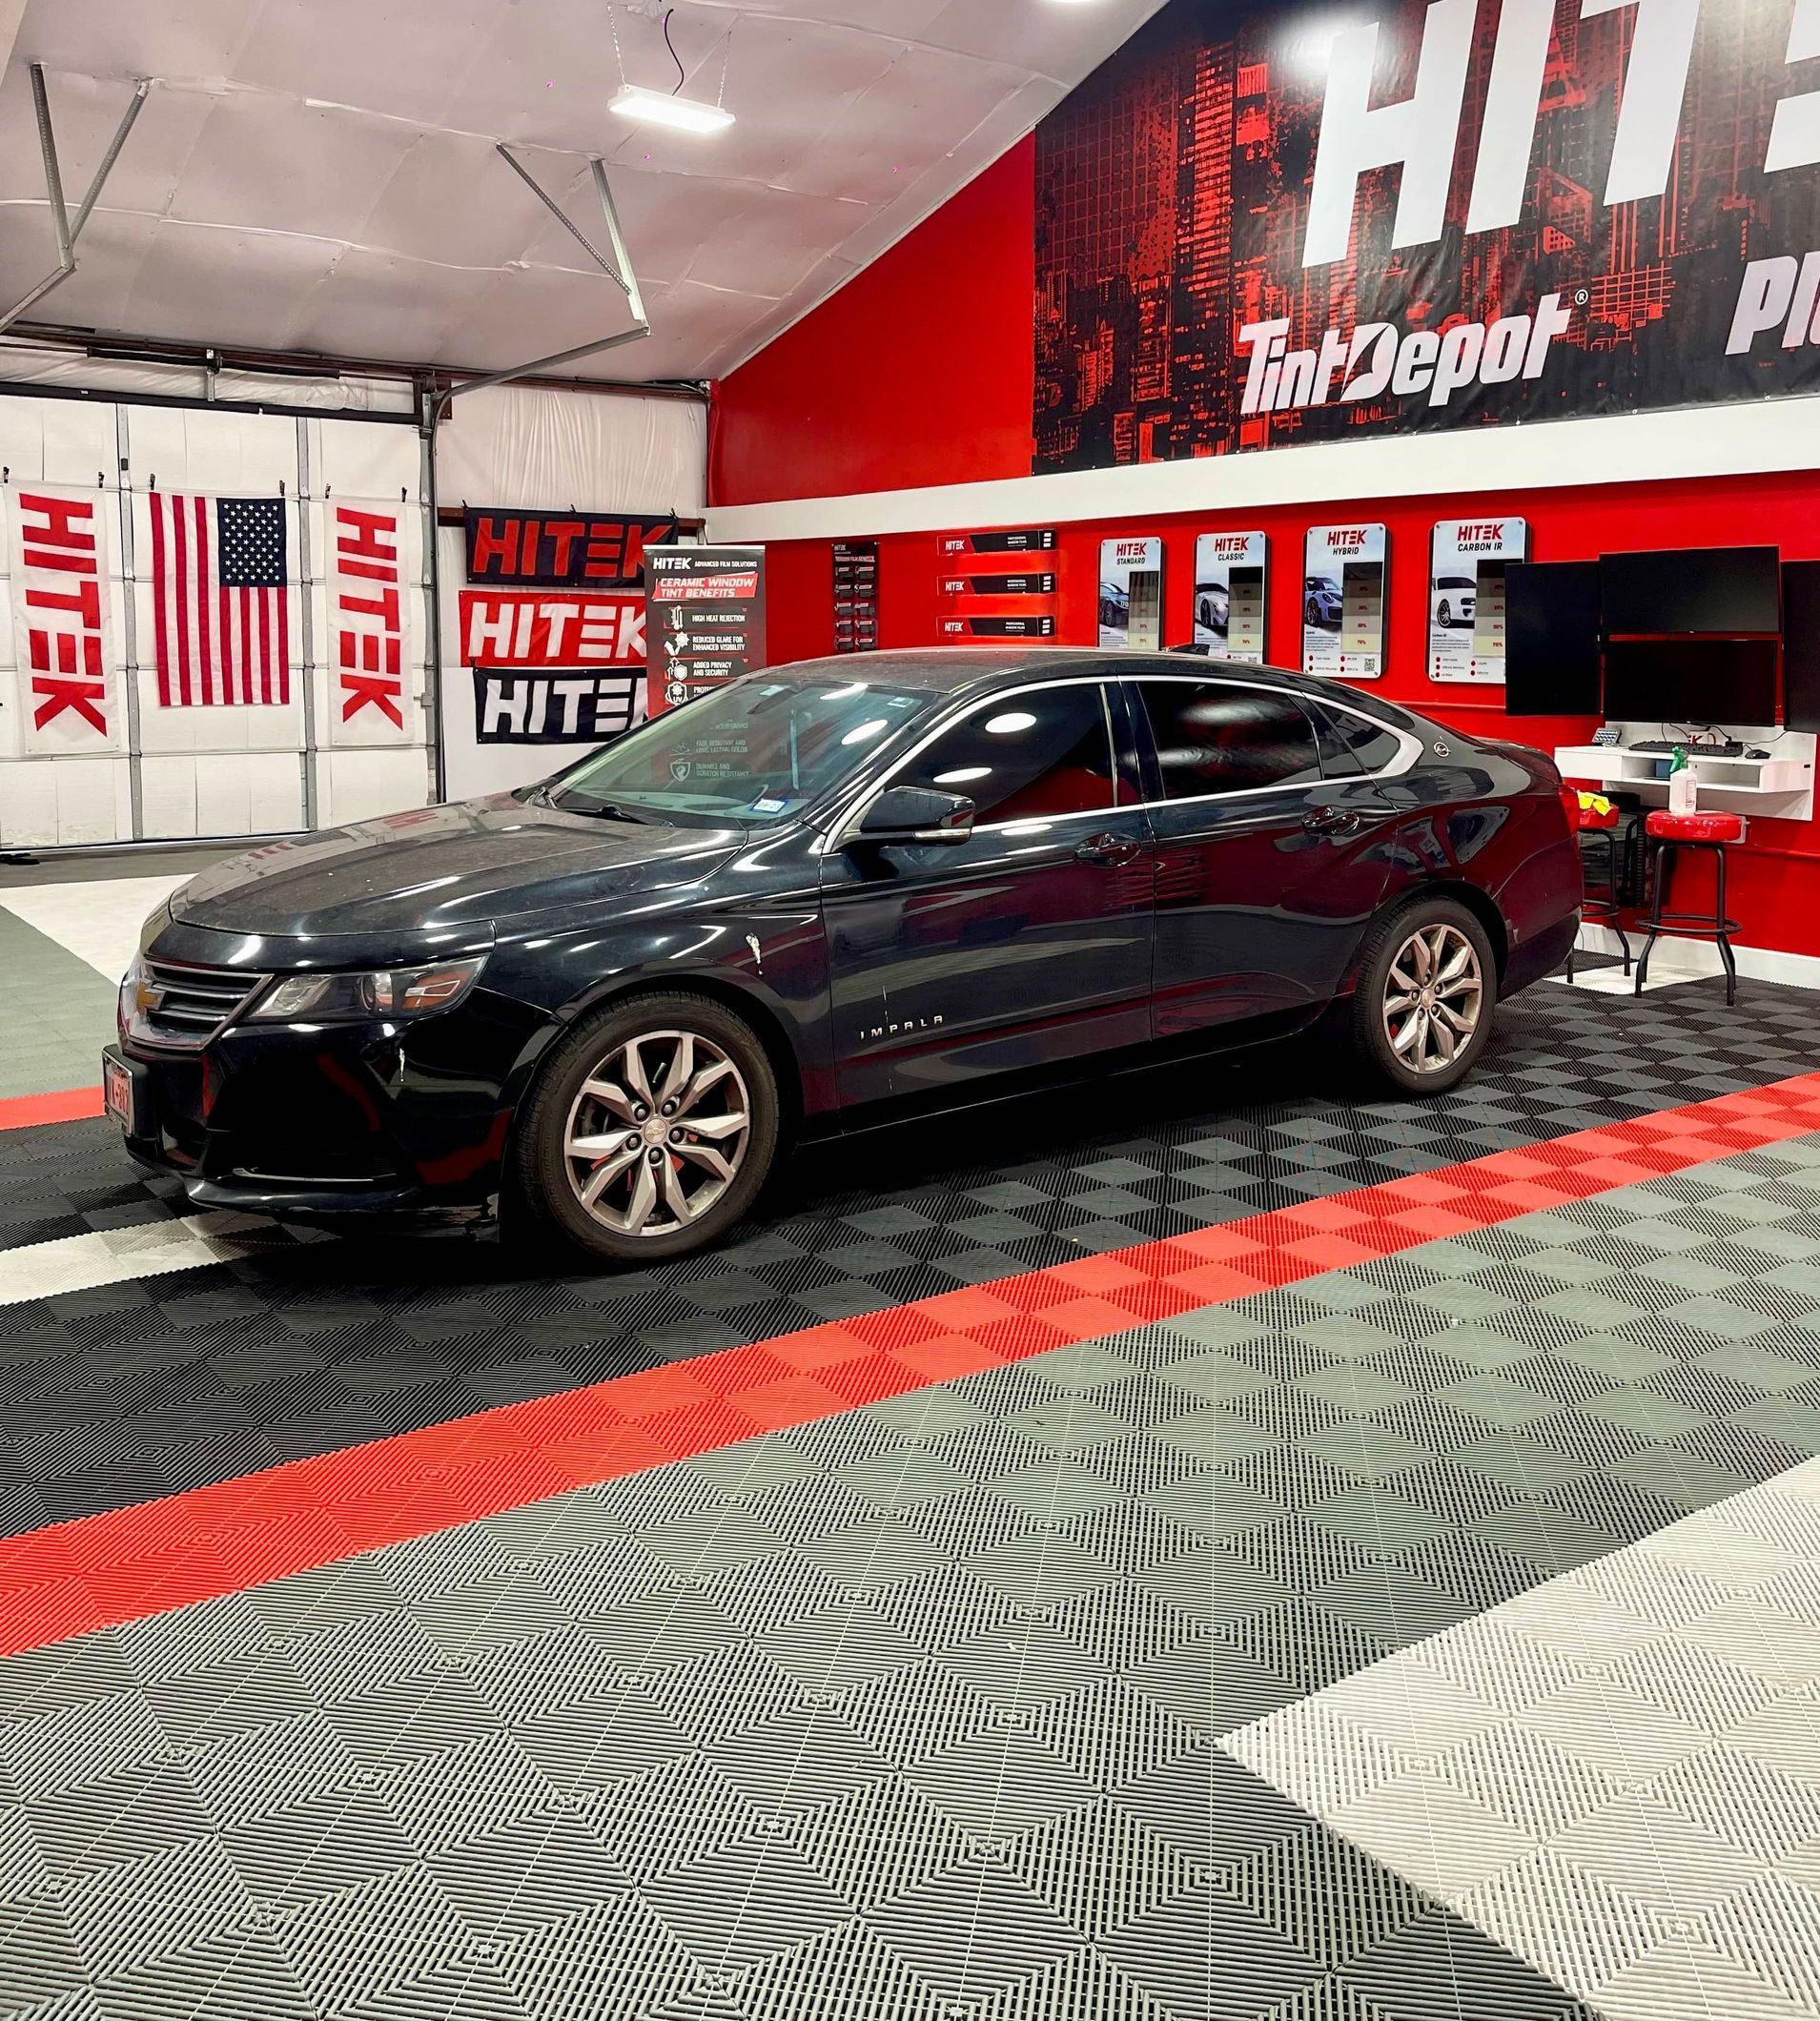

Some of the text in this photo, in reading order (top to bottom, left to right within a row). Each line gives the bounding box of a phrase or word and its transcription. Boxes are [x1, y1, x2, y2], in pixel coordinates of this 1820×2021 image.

[1725, 251, 1820, 356] Pl
[1327, 529, 1367, 546] HITEK
[1457, 523, 1505, 541] HITEK
[473, 518, 673, 578] HITEK
[945, 540, 965, 550] HITEK
[1116, 542, 1147, 556] HITEK
[1214, 537, 1250, 552] HITEK
[1333, 546, 1359, 556] HYBRID
[1458, 541, 1503, 552] CARBON IR
[652, 558, 692, 569] HITEK
[660, 578, 754, 587] CERAMIC WINDOW
[945, 581, 965, 591] HITEK
[661, 588, 735, 598] TINT BENEFITS
[18, 492, 108, 738] HITEK
[336, 506, 404, 731] HITEK
[944, 622, 964, 632] HITEK
[860, 1015, 943, 1040] IMPALA
